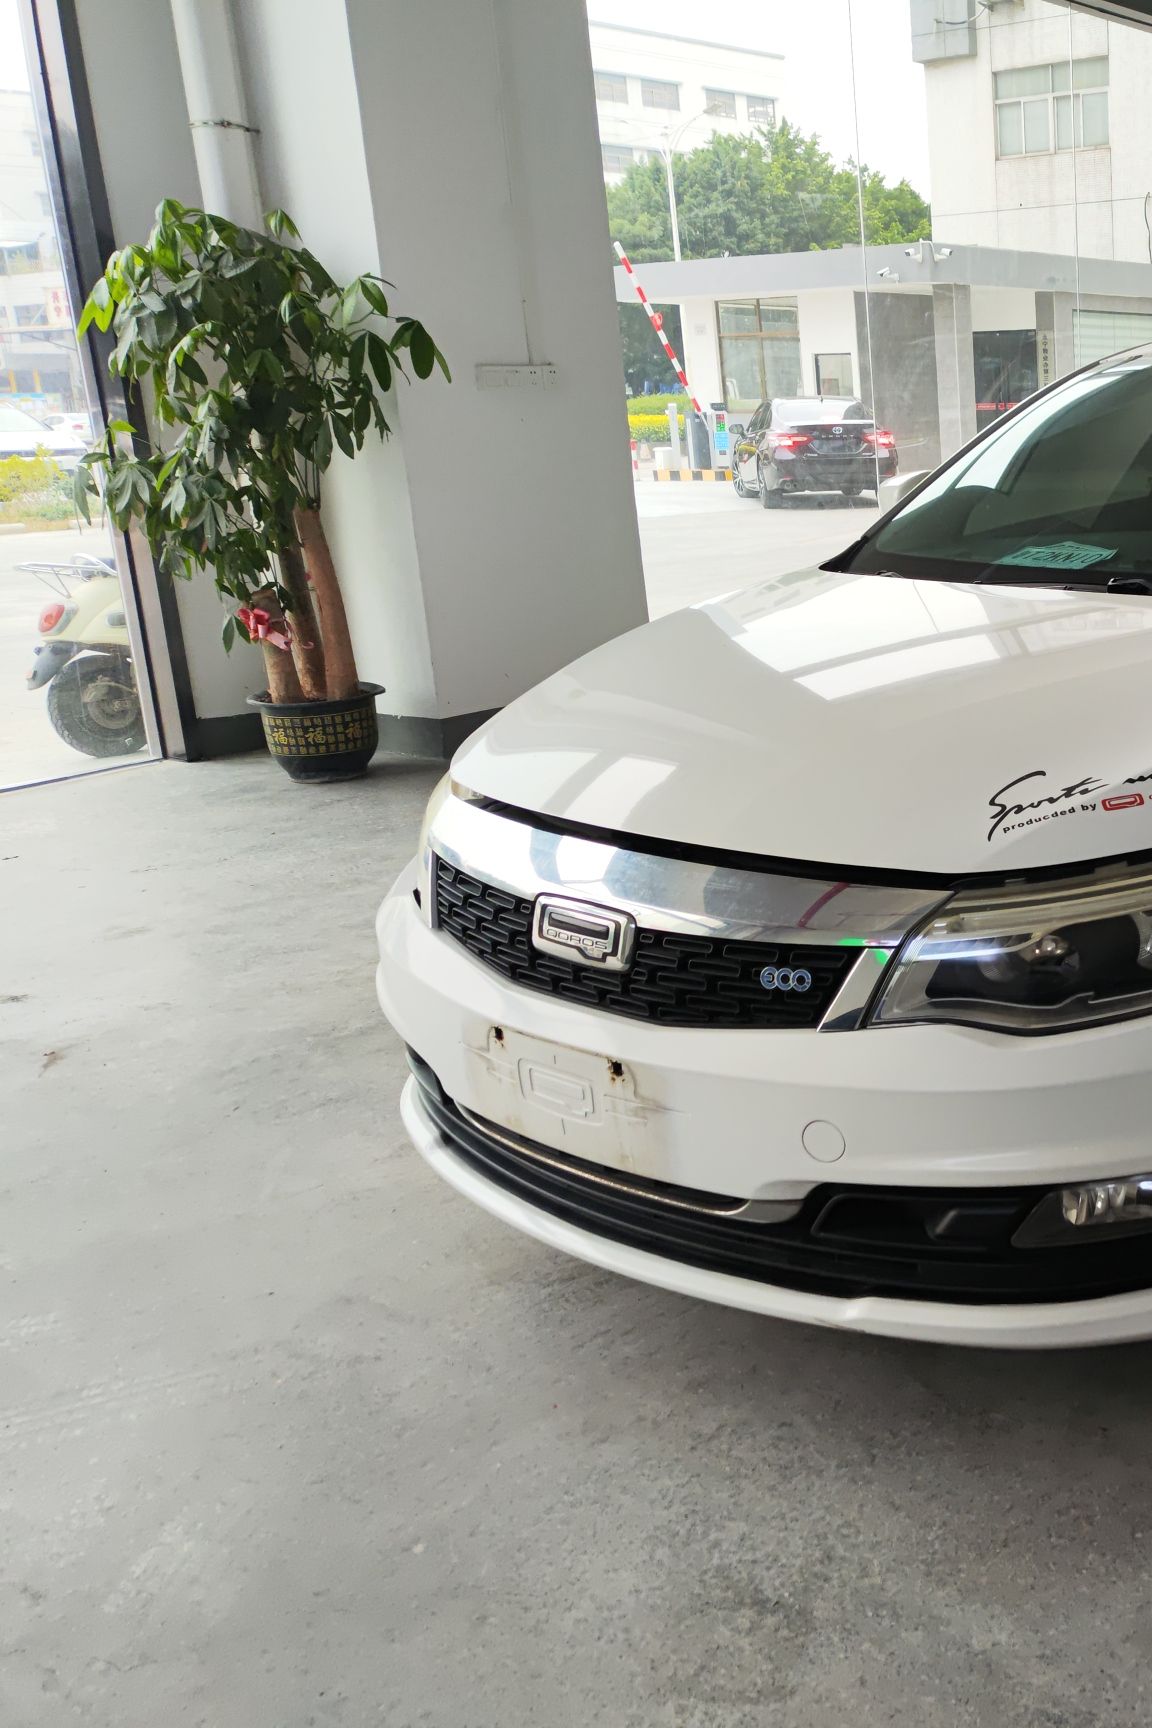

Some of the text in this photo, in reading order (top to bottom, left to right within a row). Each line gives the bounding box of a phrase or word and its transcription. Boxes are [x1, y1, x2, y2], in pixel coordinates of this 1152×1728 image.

[272, 728, 288, 745] 福
[305, 727, 326, 744] 福
[1080, 803, 1097, 813] by
[546, 928, 608, 950] QOROS
